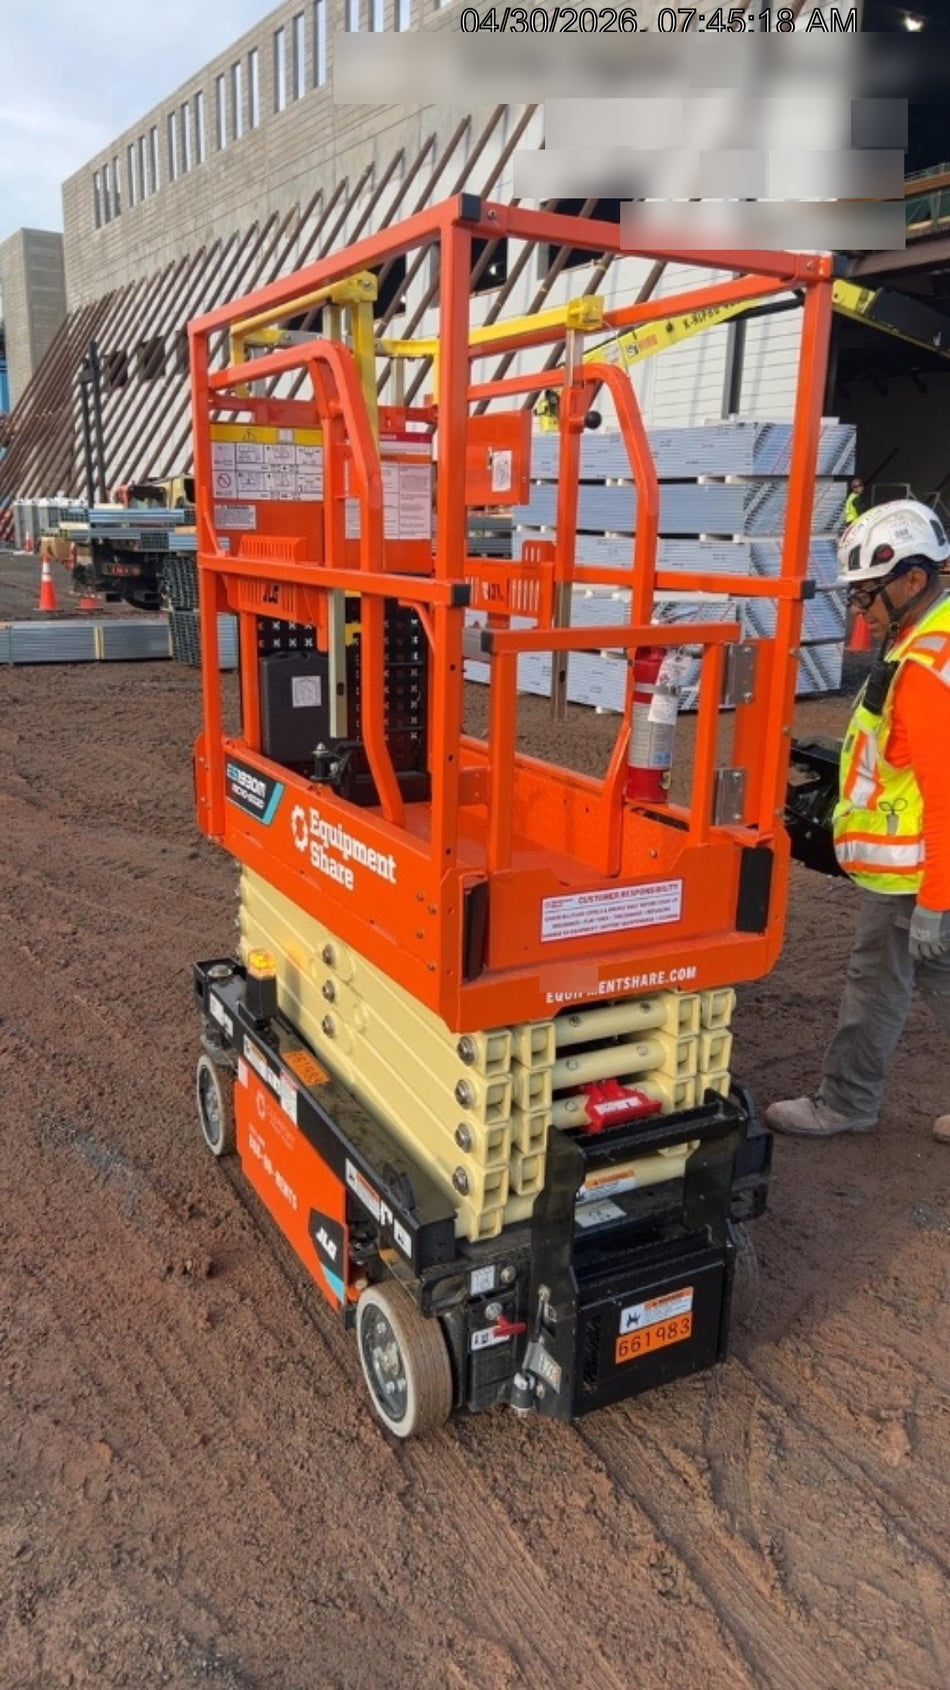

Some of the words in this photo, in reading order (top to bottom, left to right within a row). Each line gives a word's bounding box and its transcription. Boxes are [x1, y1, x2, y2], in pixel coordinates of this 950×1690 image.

[309, 807, 397, 884] Equipment
[309, 840, 354, 891] Share
[315, 1226, 338, 1261] JLG
[618, 1318, 691, 1357] 661983
